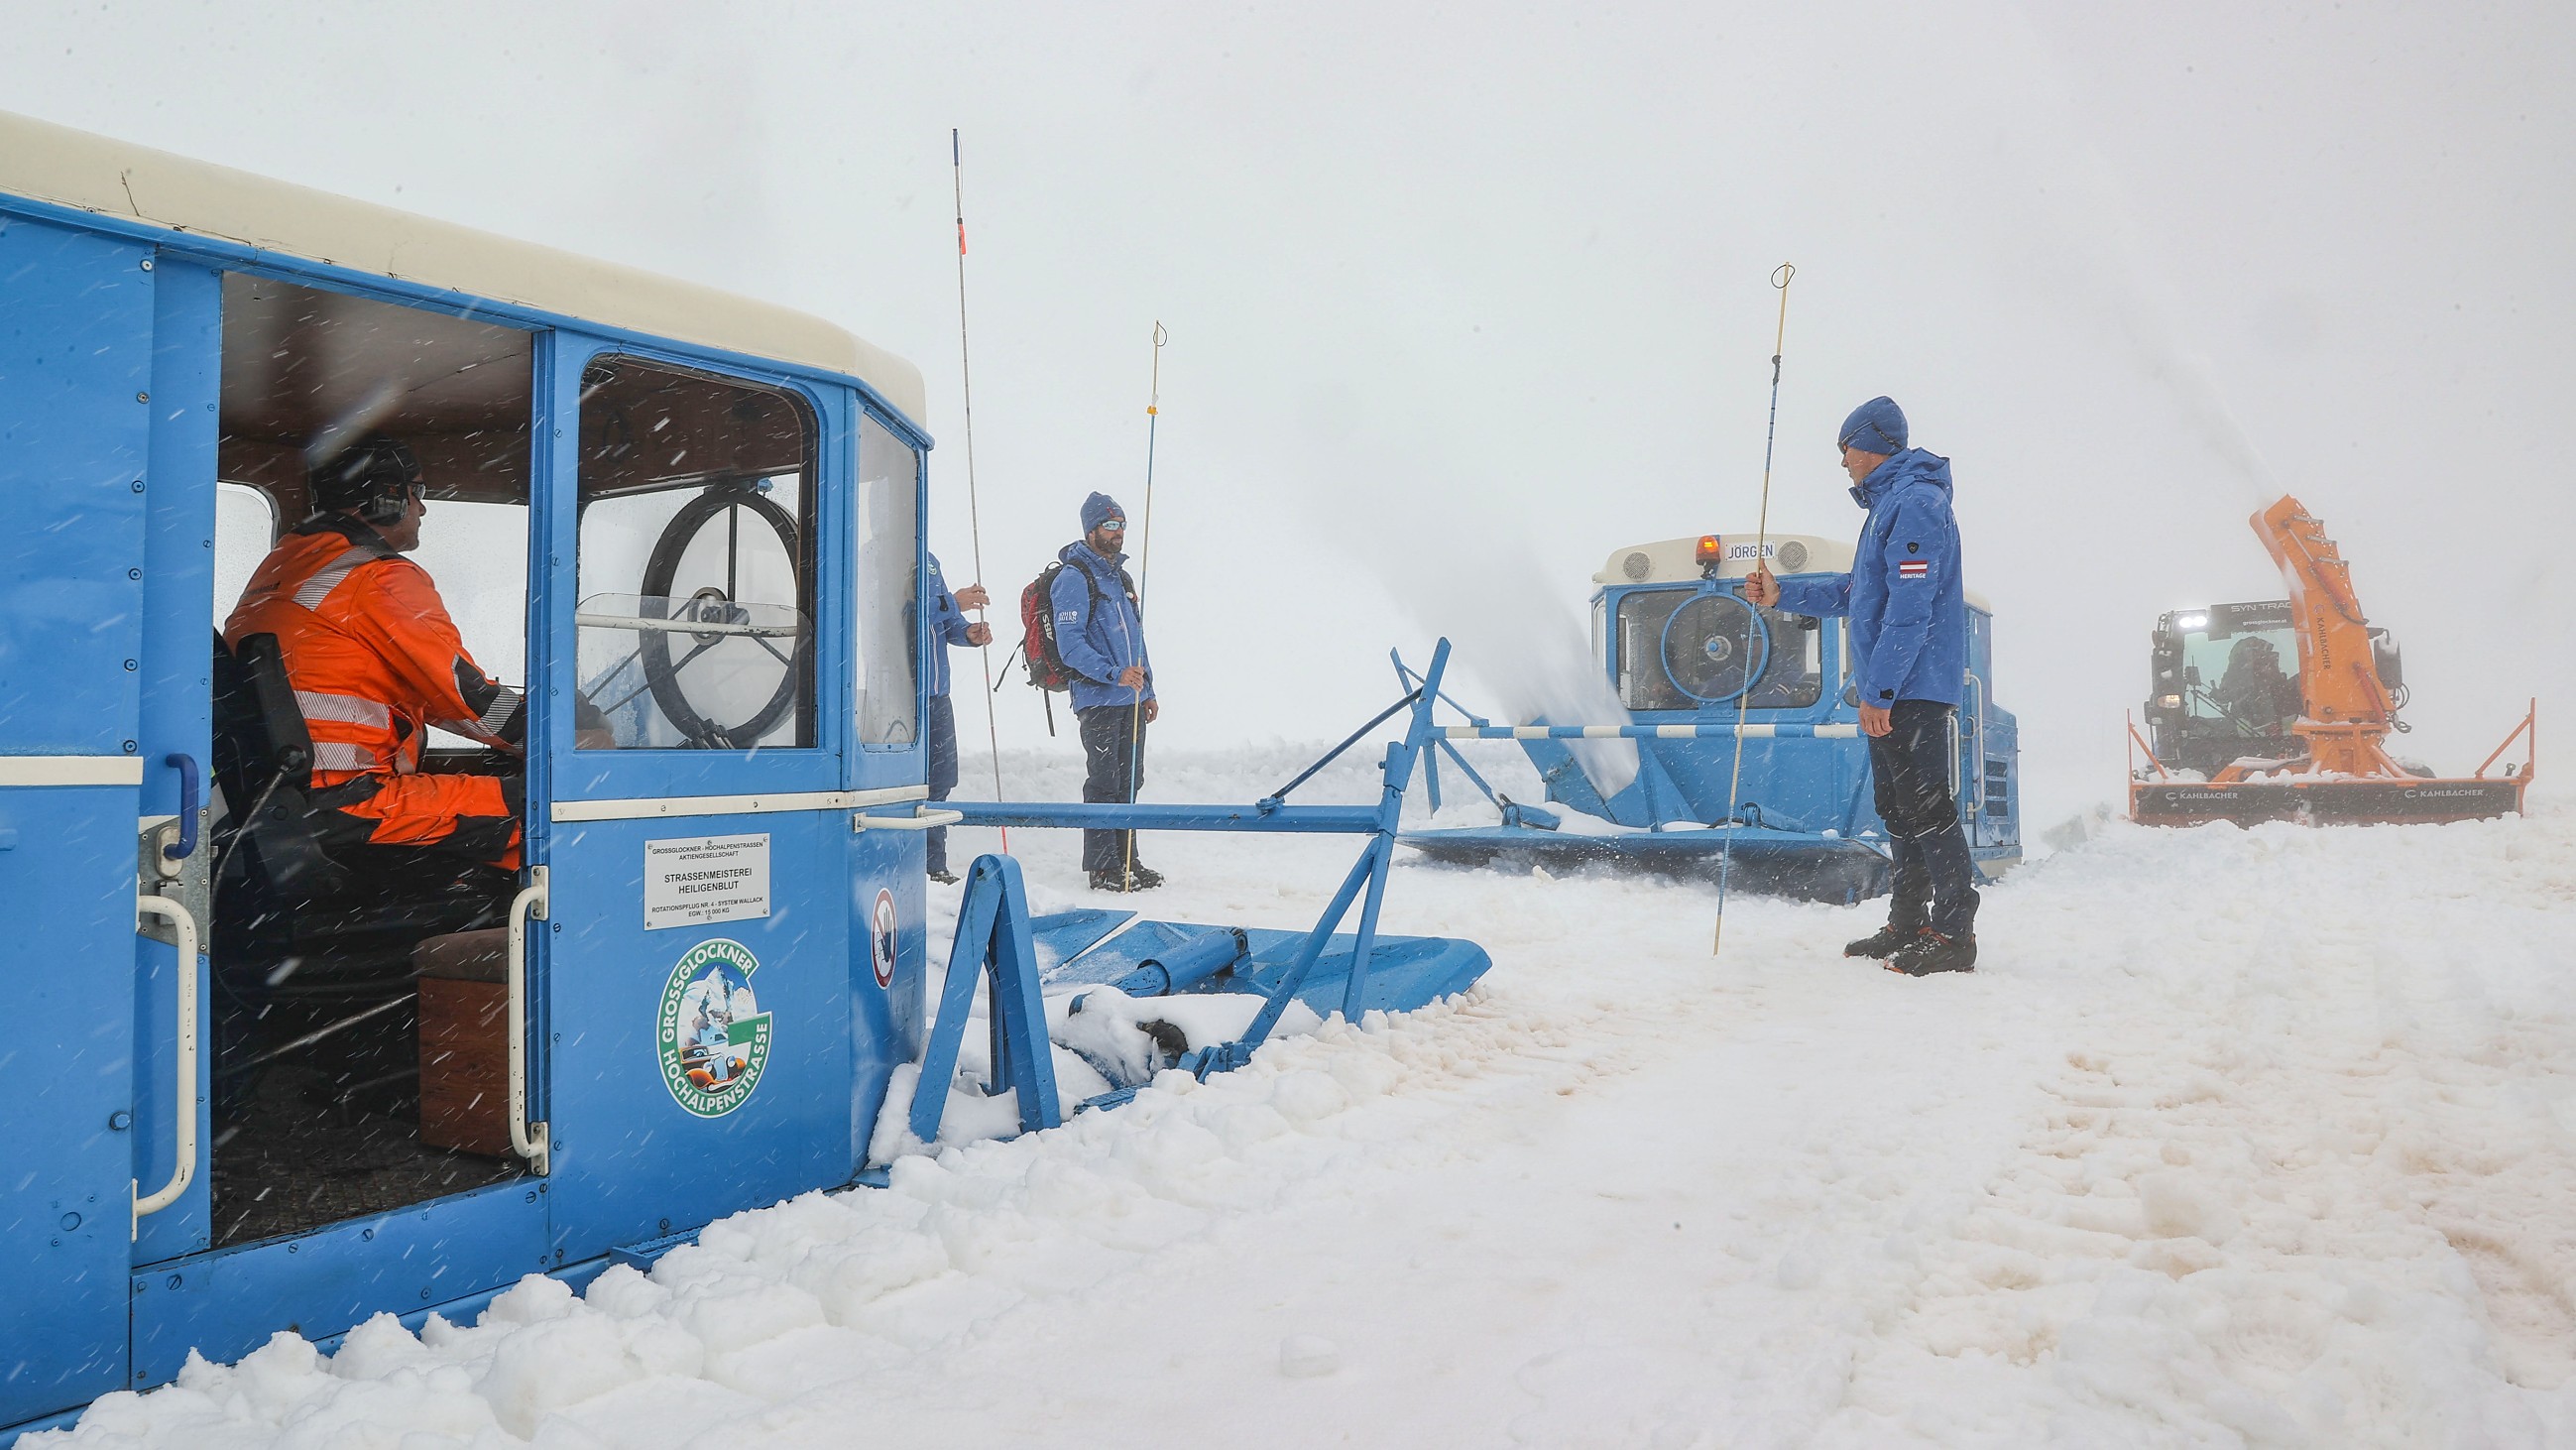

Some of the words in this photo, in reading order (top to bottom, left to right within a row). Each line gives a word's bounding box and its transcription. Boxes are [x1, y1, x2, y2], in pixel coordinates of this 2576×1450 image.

[1728, 544, 1773, 558] JÖRGEN
[2231, 603, 2257, 612] SYN
[1042, 614, 1054, 641] ABS
[2316, 617, 2331, 669] KAHLBACHER
[652, 845, 701, 855] GROSSGLOCKNER
[705, 842, 763, 851] HOCHALPENSTRASSEN
[679, 851, 739, 860] AKTIENGESELLSCHAFT
[664, 868, 752, 883] STRASSENMEISTEREI
[678, 881, 739, 894] HEILIGENBLUT
[651, 903, 700, 912] ROTATIONSPFLUG
[662, 944, 753, 1043] GROSSGLOCKNER
[663, 1023, 767, 1112] HOCHALPENSTRASSE
